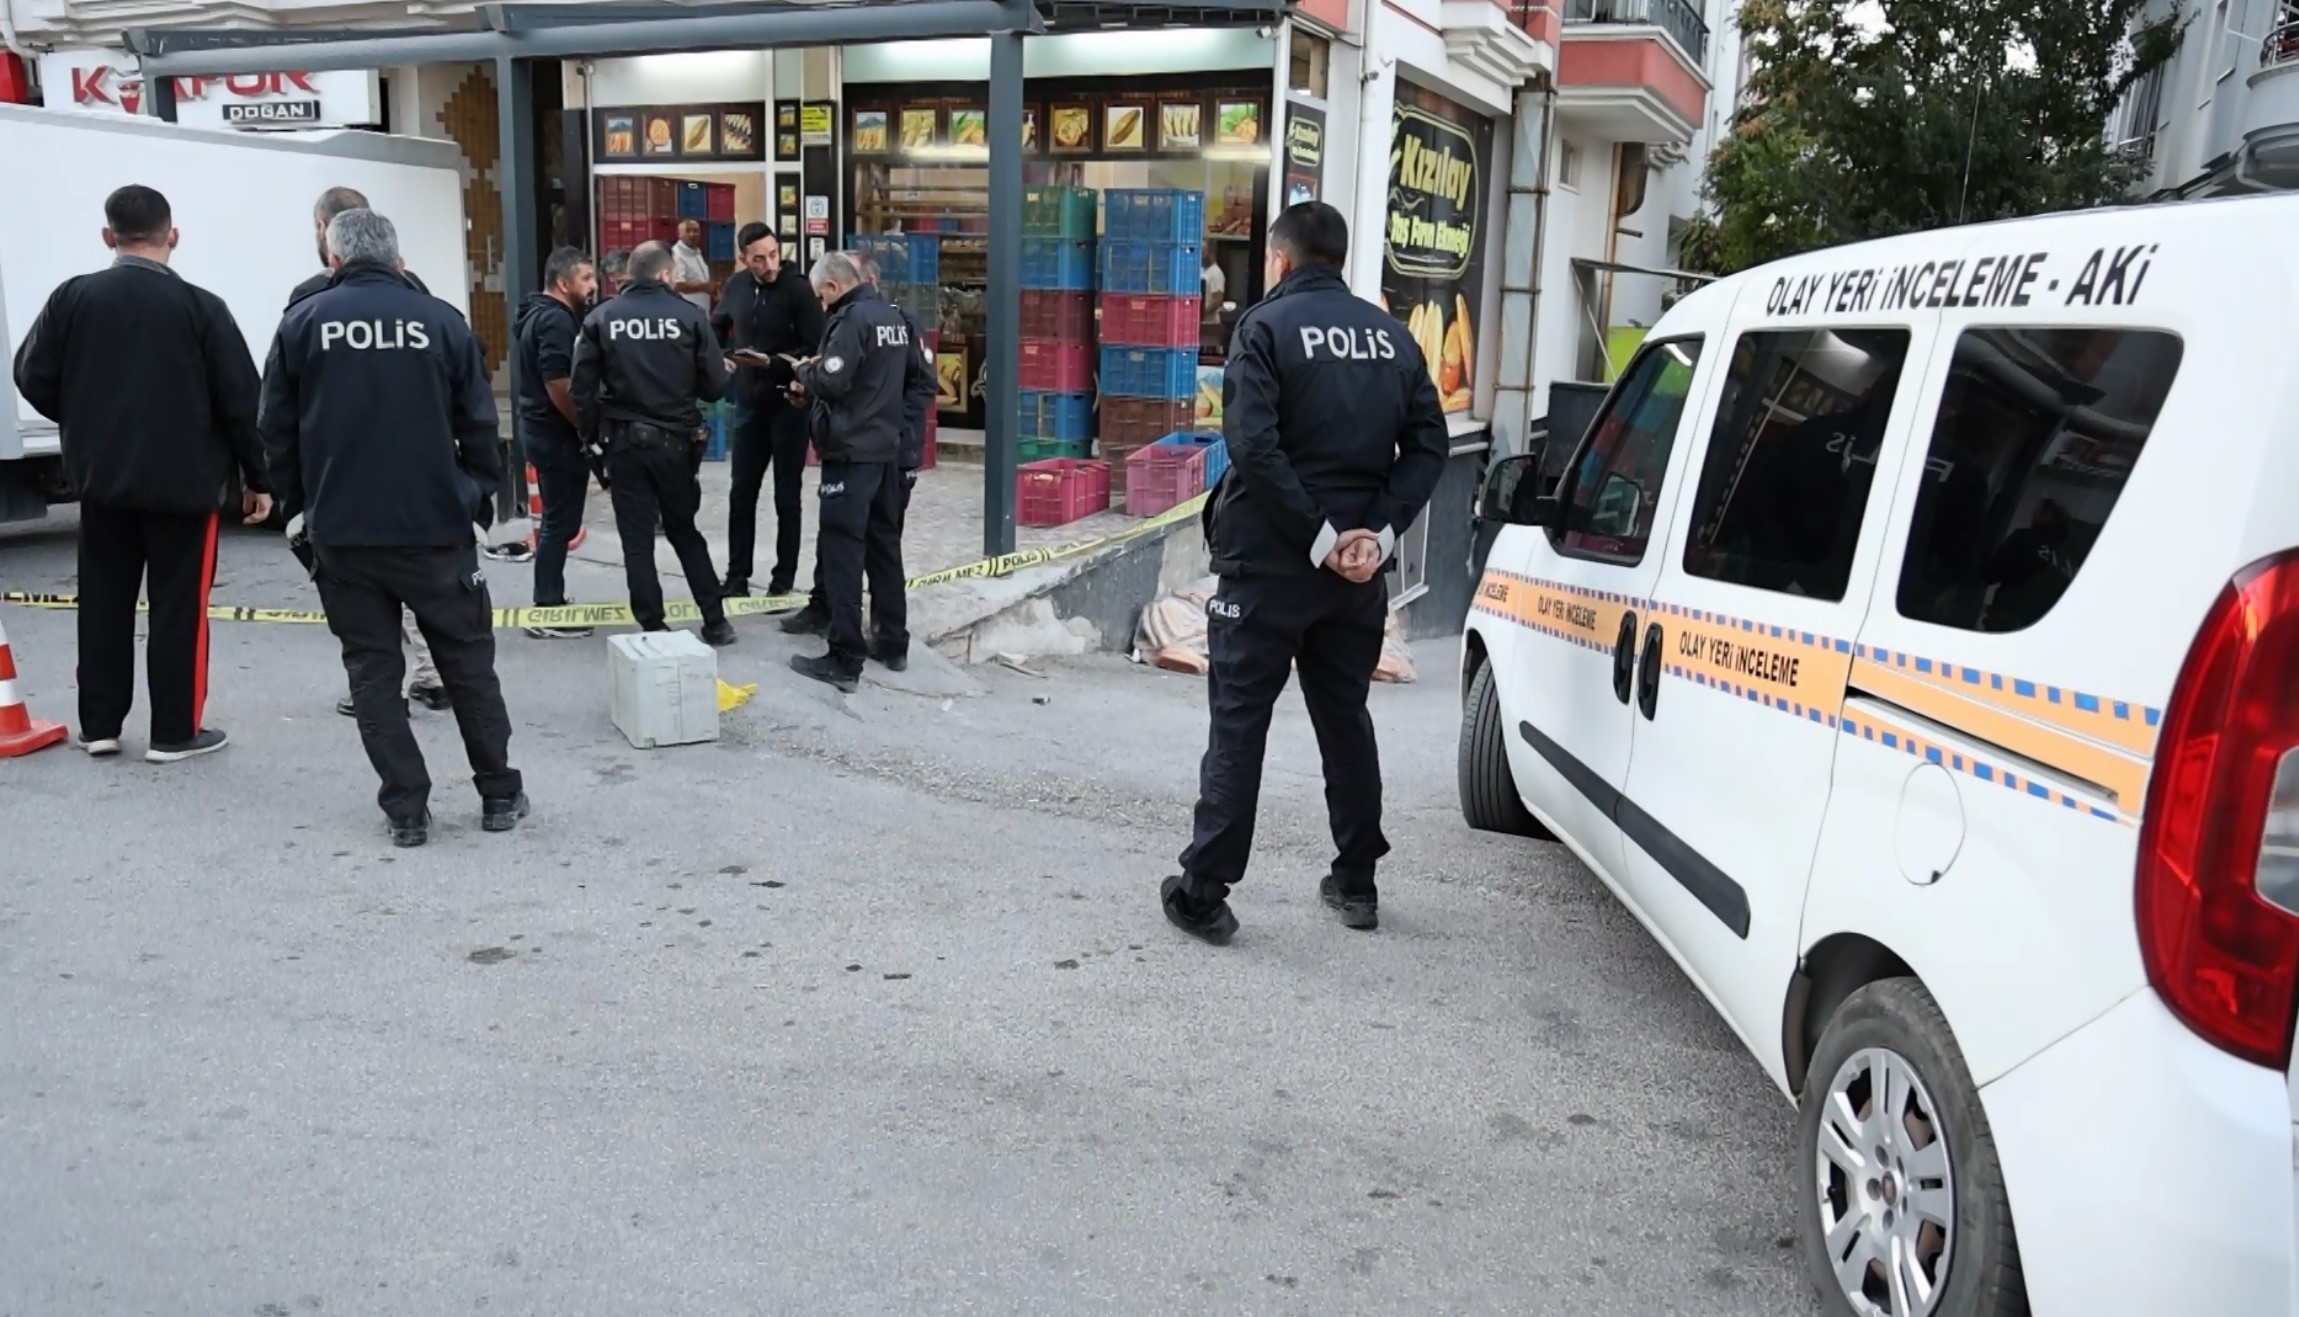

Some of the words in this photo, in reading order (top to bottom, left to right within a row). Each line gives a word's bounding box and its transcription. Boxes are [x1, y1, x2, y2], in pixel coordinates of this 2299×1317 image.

[1400, 133, 1472, 211] Kızılay
[1766, 273, 1825, 317] OLAY
[1679, 631, 1707, 660] OLAY
